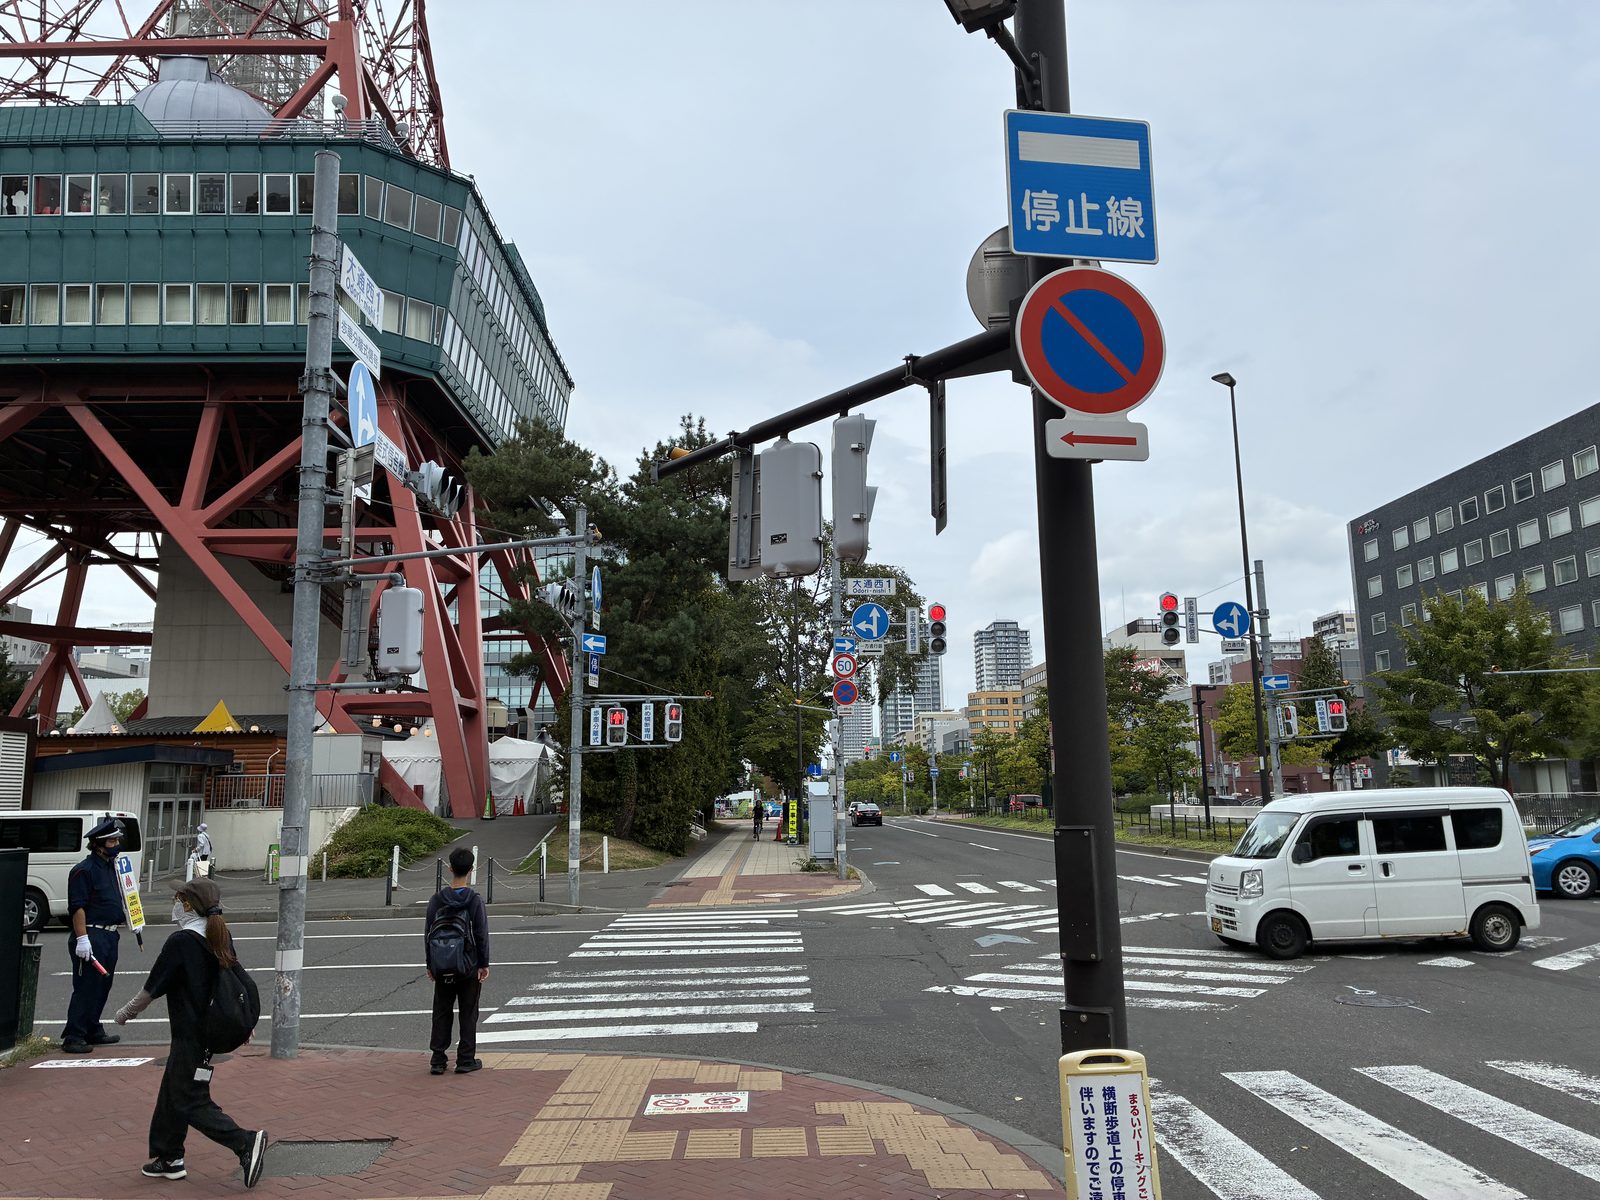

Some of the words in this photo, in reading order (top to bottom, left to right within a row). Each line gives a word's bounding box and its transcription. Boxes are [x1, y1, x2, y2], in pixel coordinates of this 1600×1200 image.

[1021, 188, 1146, 239] 停止線
[346, 256, 381, 313] 大通西1
[852, 579, 892, 589] 大通西1
[837, 660, 852, 672] 50
[121, 858, 128, 872] P
